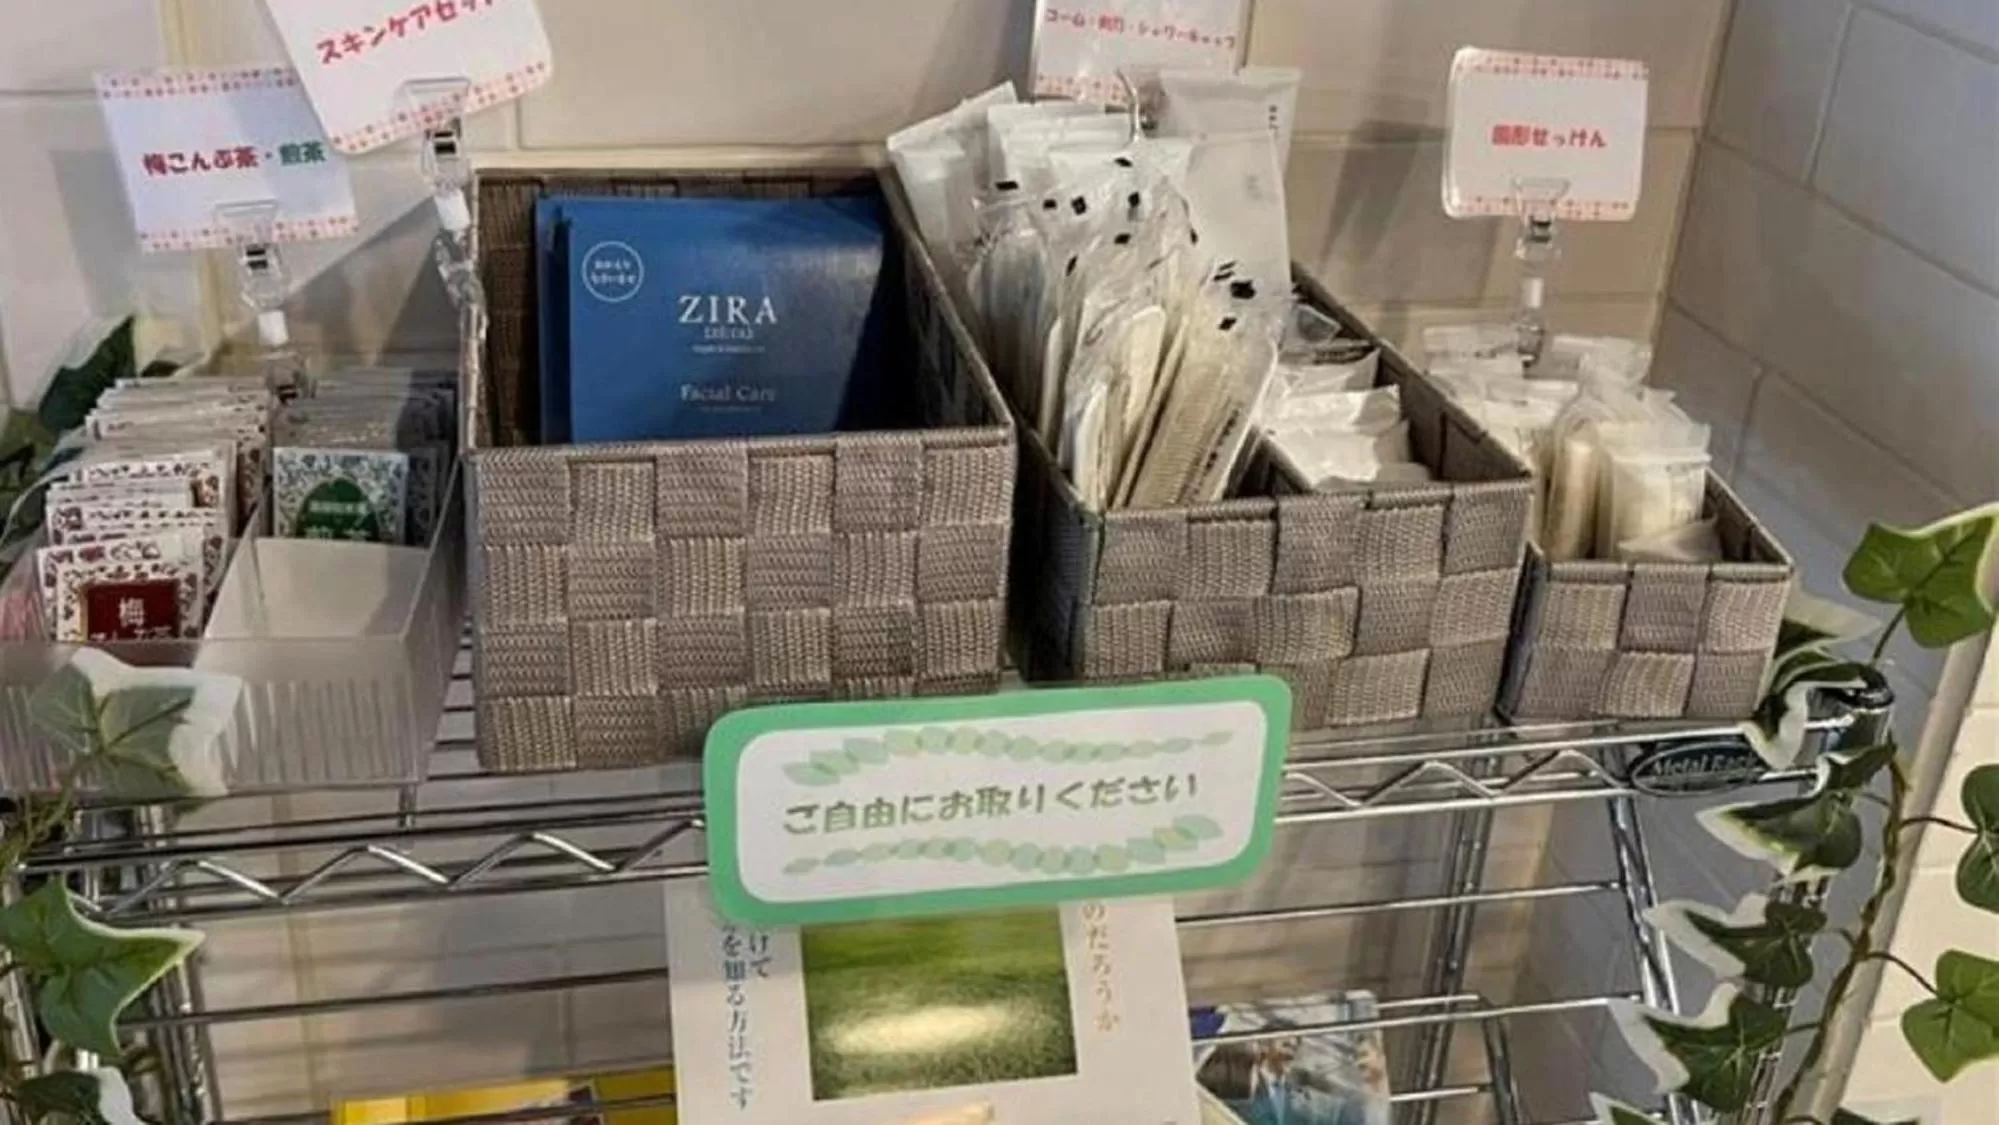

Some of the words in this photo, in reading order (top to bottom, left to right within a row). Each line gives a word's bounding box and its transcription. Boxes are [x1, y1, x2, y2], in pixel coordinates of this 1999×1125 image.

[316, 0, 493, 64] スキンケアセッ
[678, 295, 778, 325] ZIRA
[681, 383, 731, 401] Facial
[735, 385, 776, 402] Care
[783, 773, 1199, 836] ご自由にお取りください
